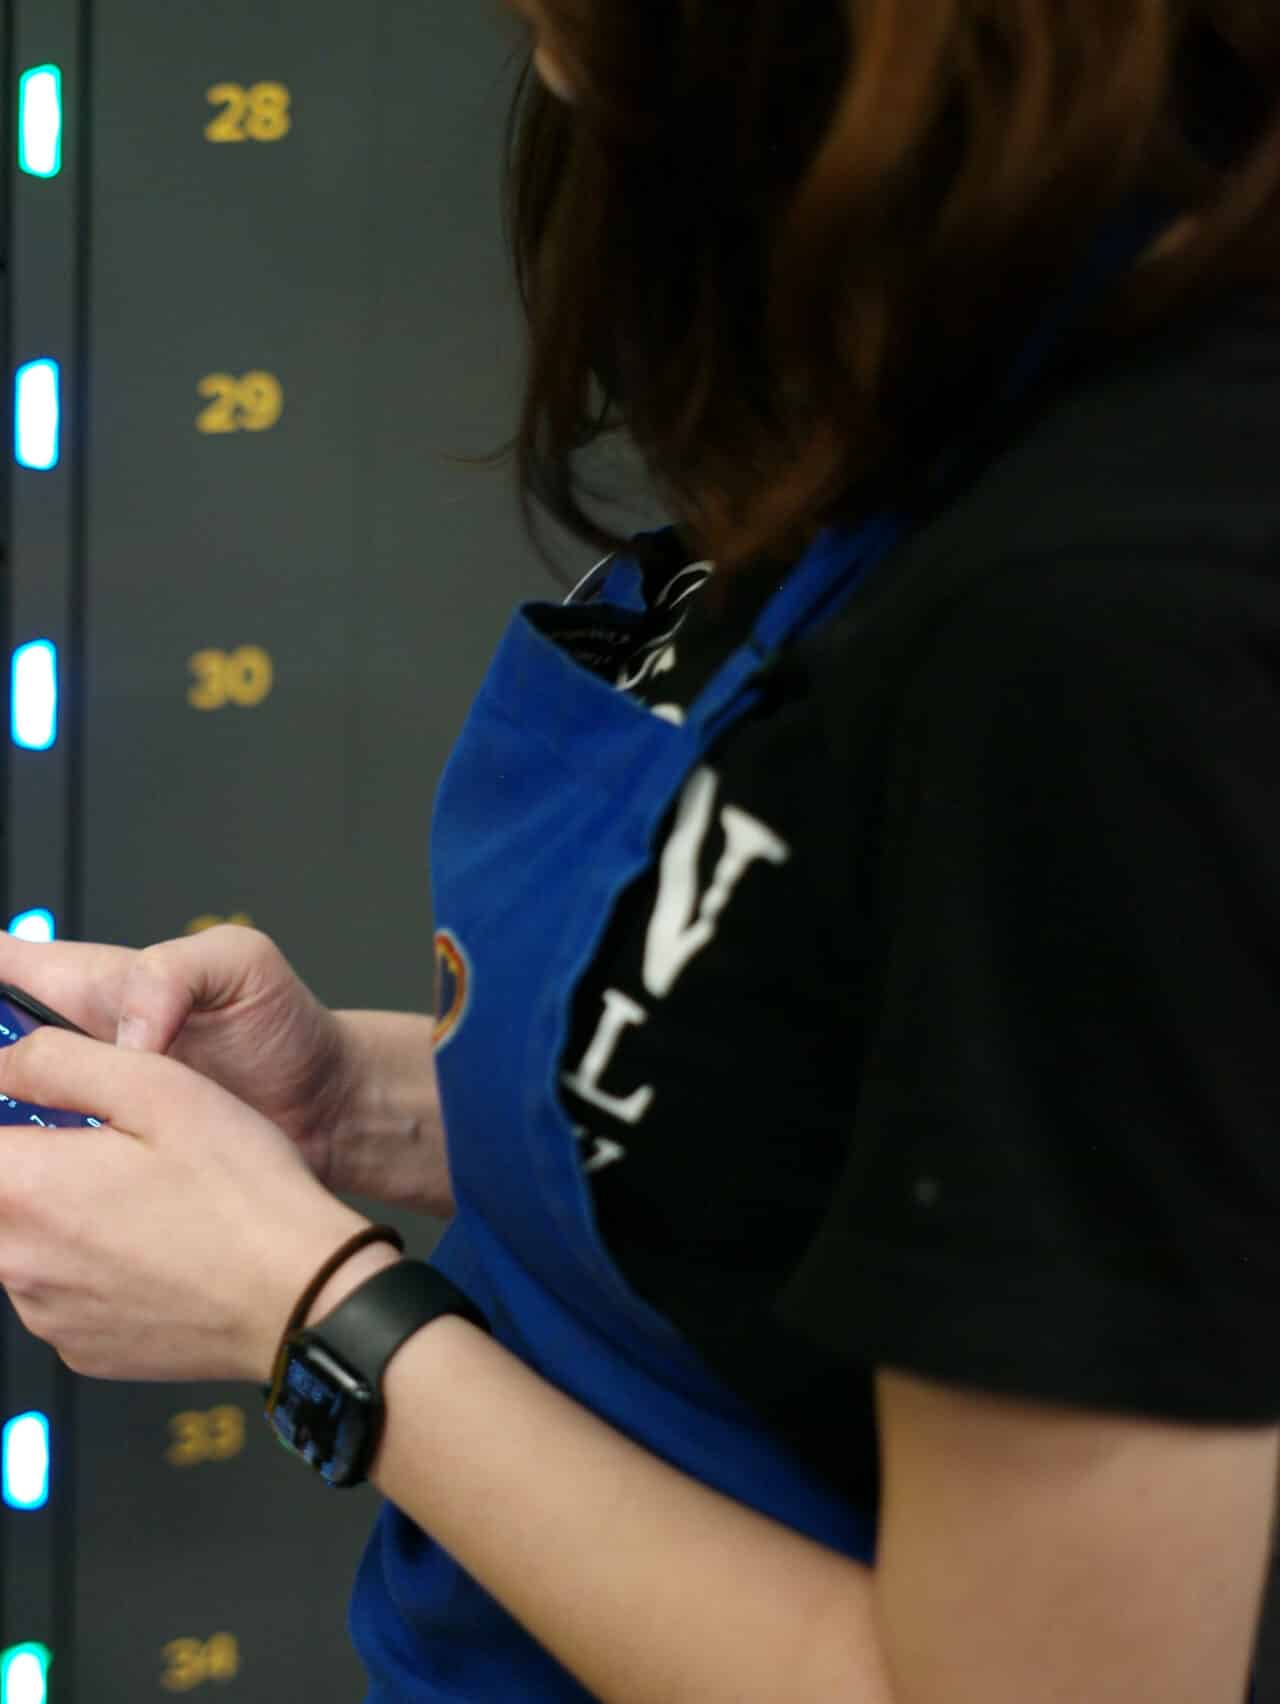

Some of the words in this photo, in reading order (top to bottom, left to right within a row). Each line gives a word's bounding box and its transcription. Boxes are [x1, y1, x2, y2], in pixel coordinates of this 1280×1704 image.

[205, 81, 290, 143] 28
[196, 370, 282, 434] 29
[187, 646, 272, 709] 30
